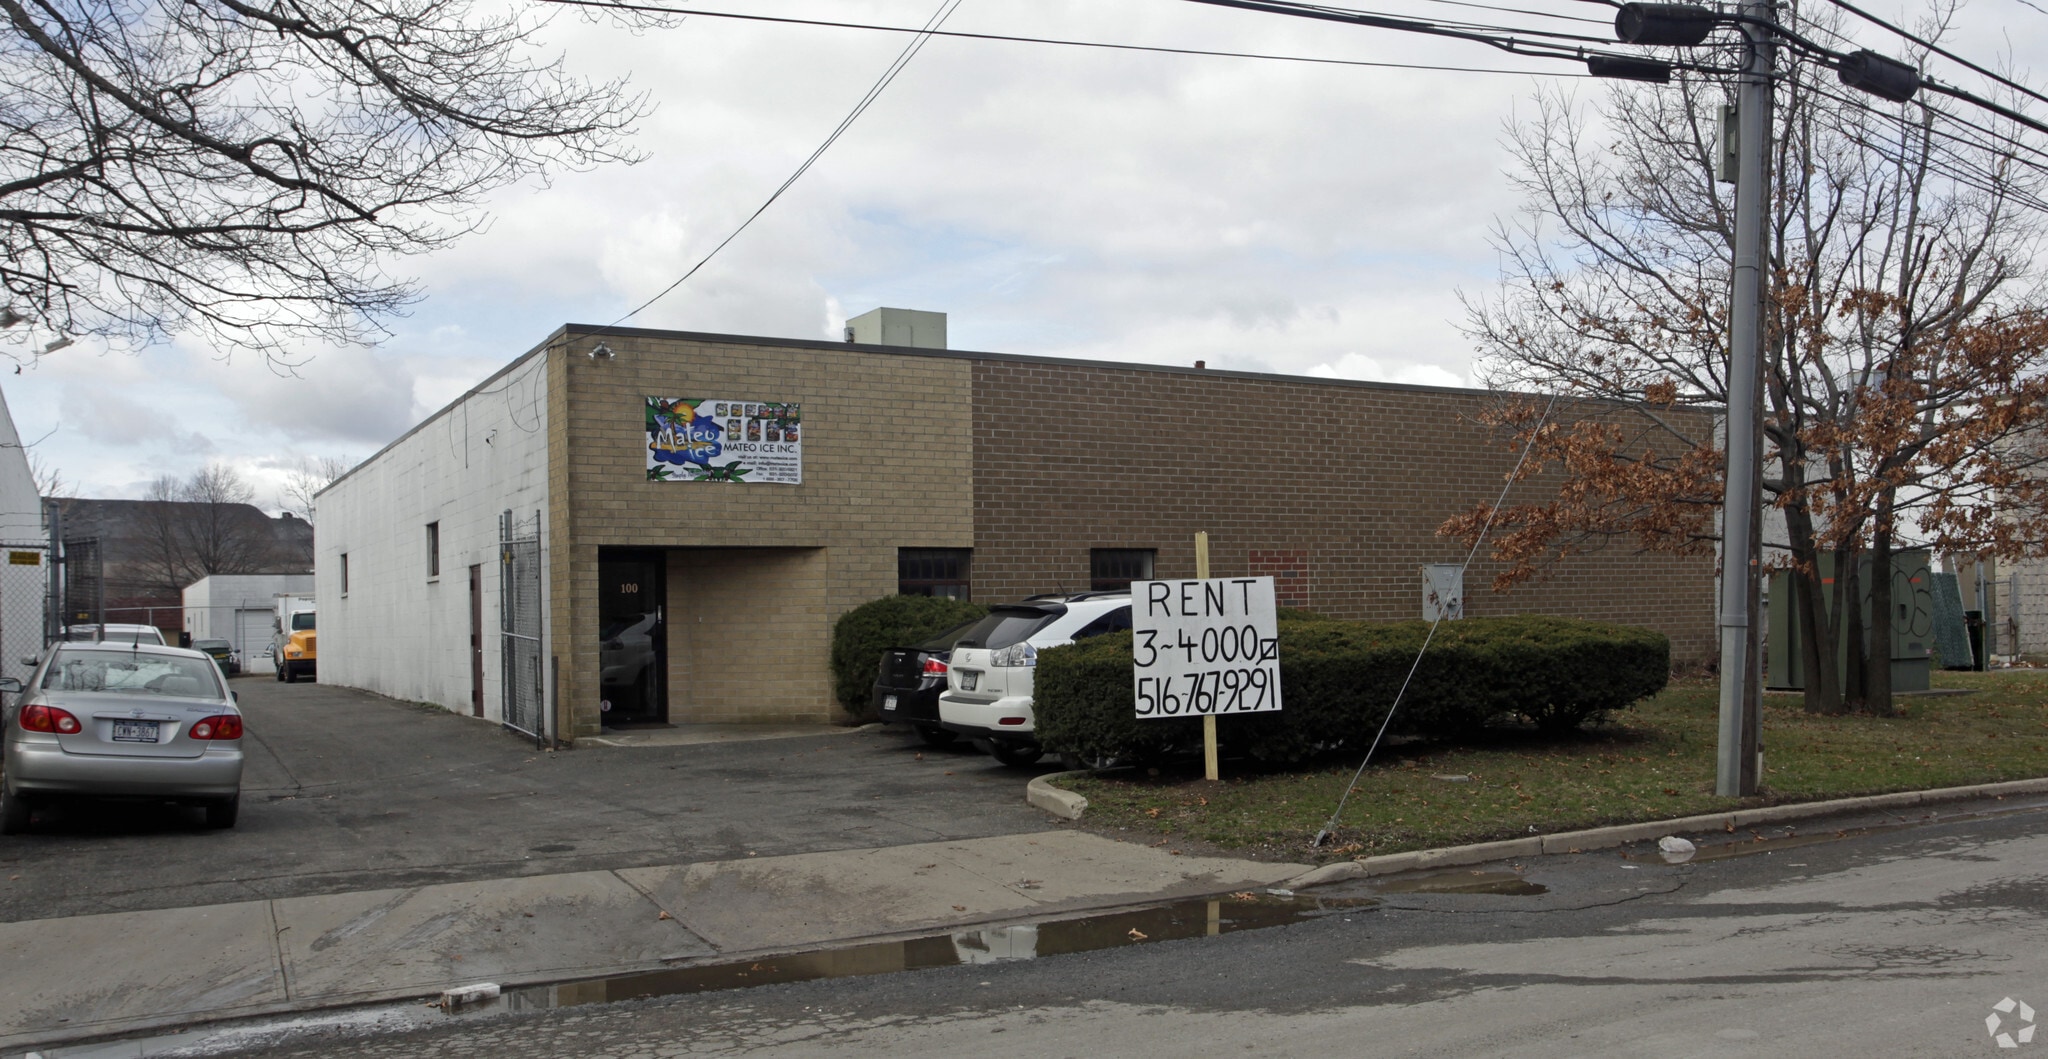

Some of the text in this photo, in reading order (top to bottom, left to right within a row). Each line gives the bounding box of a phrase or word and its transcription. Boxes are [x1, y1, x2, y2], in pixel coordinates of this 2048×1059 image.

[656, 423, 715, 453] Mateo
[723, 443, 797, 454] MATEO ICE INC.
[620, 583, 638, 593] 100
[1148, 580, 1257, 617] RENT
